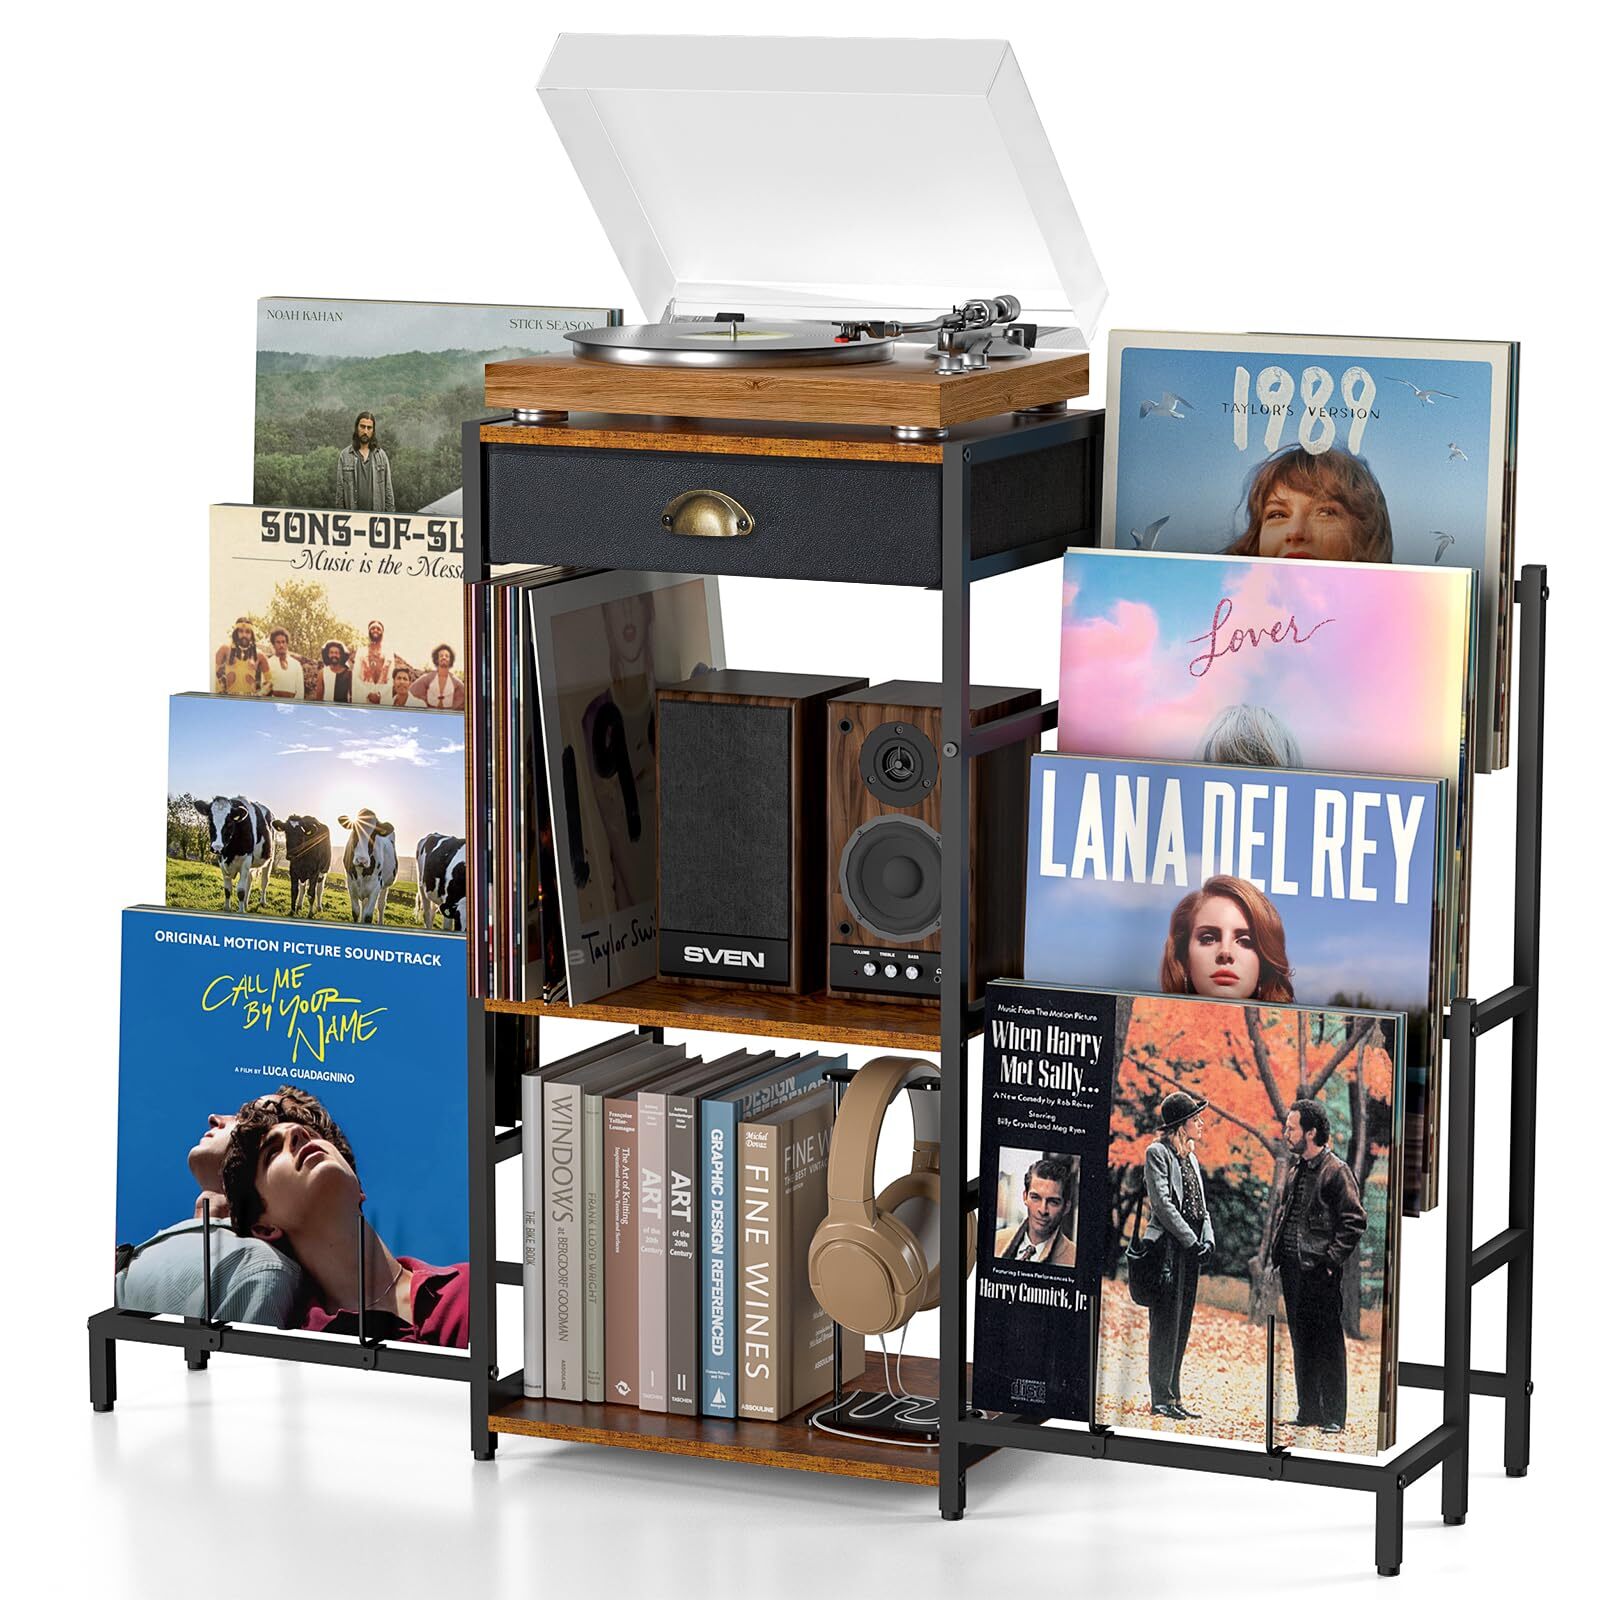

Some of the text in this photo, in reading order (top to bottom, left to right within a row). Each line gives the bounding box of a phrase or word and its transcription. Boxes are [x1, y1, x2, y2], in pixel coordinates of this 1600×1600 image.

[266, 309, 344, 322] NOAH KAHAN
[509, 318, 595, 331] STICK SEASON
[1221, 401, 1382, 421] TAYLOR'S VERSION
[1232, 365, 1377, 456] 1989
[261, 510, 464, 554] SONS-OF-SL
[289, 549, 355, 573] Music
[359, 552, 374, 575] is
[377, 553, 403, 576] the
[1186, 597, 1336, 678] Lover
[1039, 769, 1426, 905] LANA DEL REY
[154, 929, 442, 967] ORIGINAL MOTION PICTURE SOUNDTRACK
[581, 923, 628, 989] Taylor
[683, 945, 765, 969] SVEN
[201, 962, 313, 1012] CALL ME
[242, 987, 362, 1039] BY YOUR
[997, 1003, 1098, 1021] Music From The Motion Picture
[291, 1006, 389, 1064] NAME
[991, 1019, 1103, 1065] When Harry
[240, 1066, 253, 1074] FILM
[253, 1067, 262, 1075] BY
[262, 1065, 289, 1078] LUCA
[290, 1068, 356, 1084] GUADAGNINO
[1000, 1054, 1100, 1098] Met Sally...
[992, 1091, 1094, 1110] A New Comedy by Rob Reiner
[1028, 1109, 1057, 1123] Starring
[745, 1130, 769, 1142] Michel
[997, 1116, 1086, 1136] Billy Crystal and Meg Ryan
[710, 1127, 724, 1197] GRAPHIC
[784, 1135, 815, 1175] FINE
[620, 1147, 631, 1226] The Art of Knitting
[641, 1167, 663, 1220] ART
[671, 1170, 692, 1223] ART
[551, 1093, 574, 1342] WINDOWS at BERGDORF GOODMAN
[672, 1229, 690, 1239] of the
[710, 1199, 724, 1255] DESIGN
[525, 1210, 536, 1266] THE BIKE BOOK
[587, 1192, 598, 1305] FRANK LLOYD WRIGHT
[640, 1246, 663, 1257] Century
[669, 1248, 693, 1260] Century
[674, 1239, 688, 1248] 20th
[744, 1163, 770, 1380] FINE WINES
[1068, 1275, 1076, 1284] by
[711, 1258, 725, 1358] REFERENCED
[978, 1277, 1088, 1313] Harry Connick, Jr.
[677, 1373, 686, 1392] II
[741, 1402, 775, 1414] ASSOULINE
